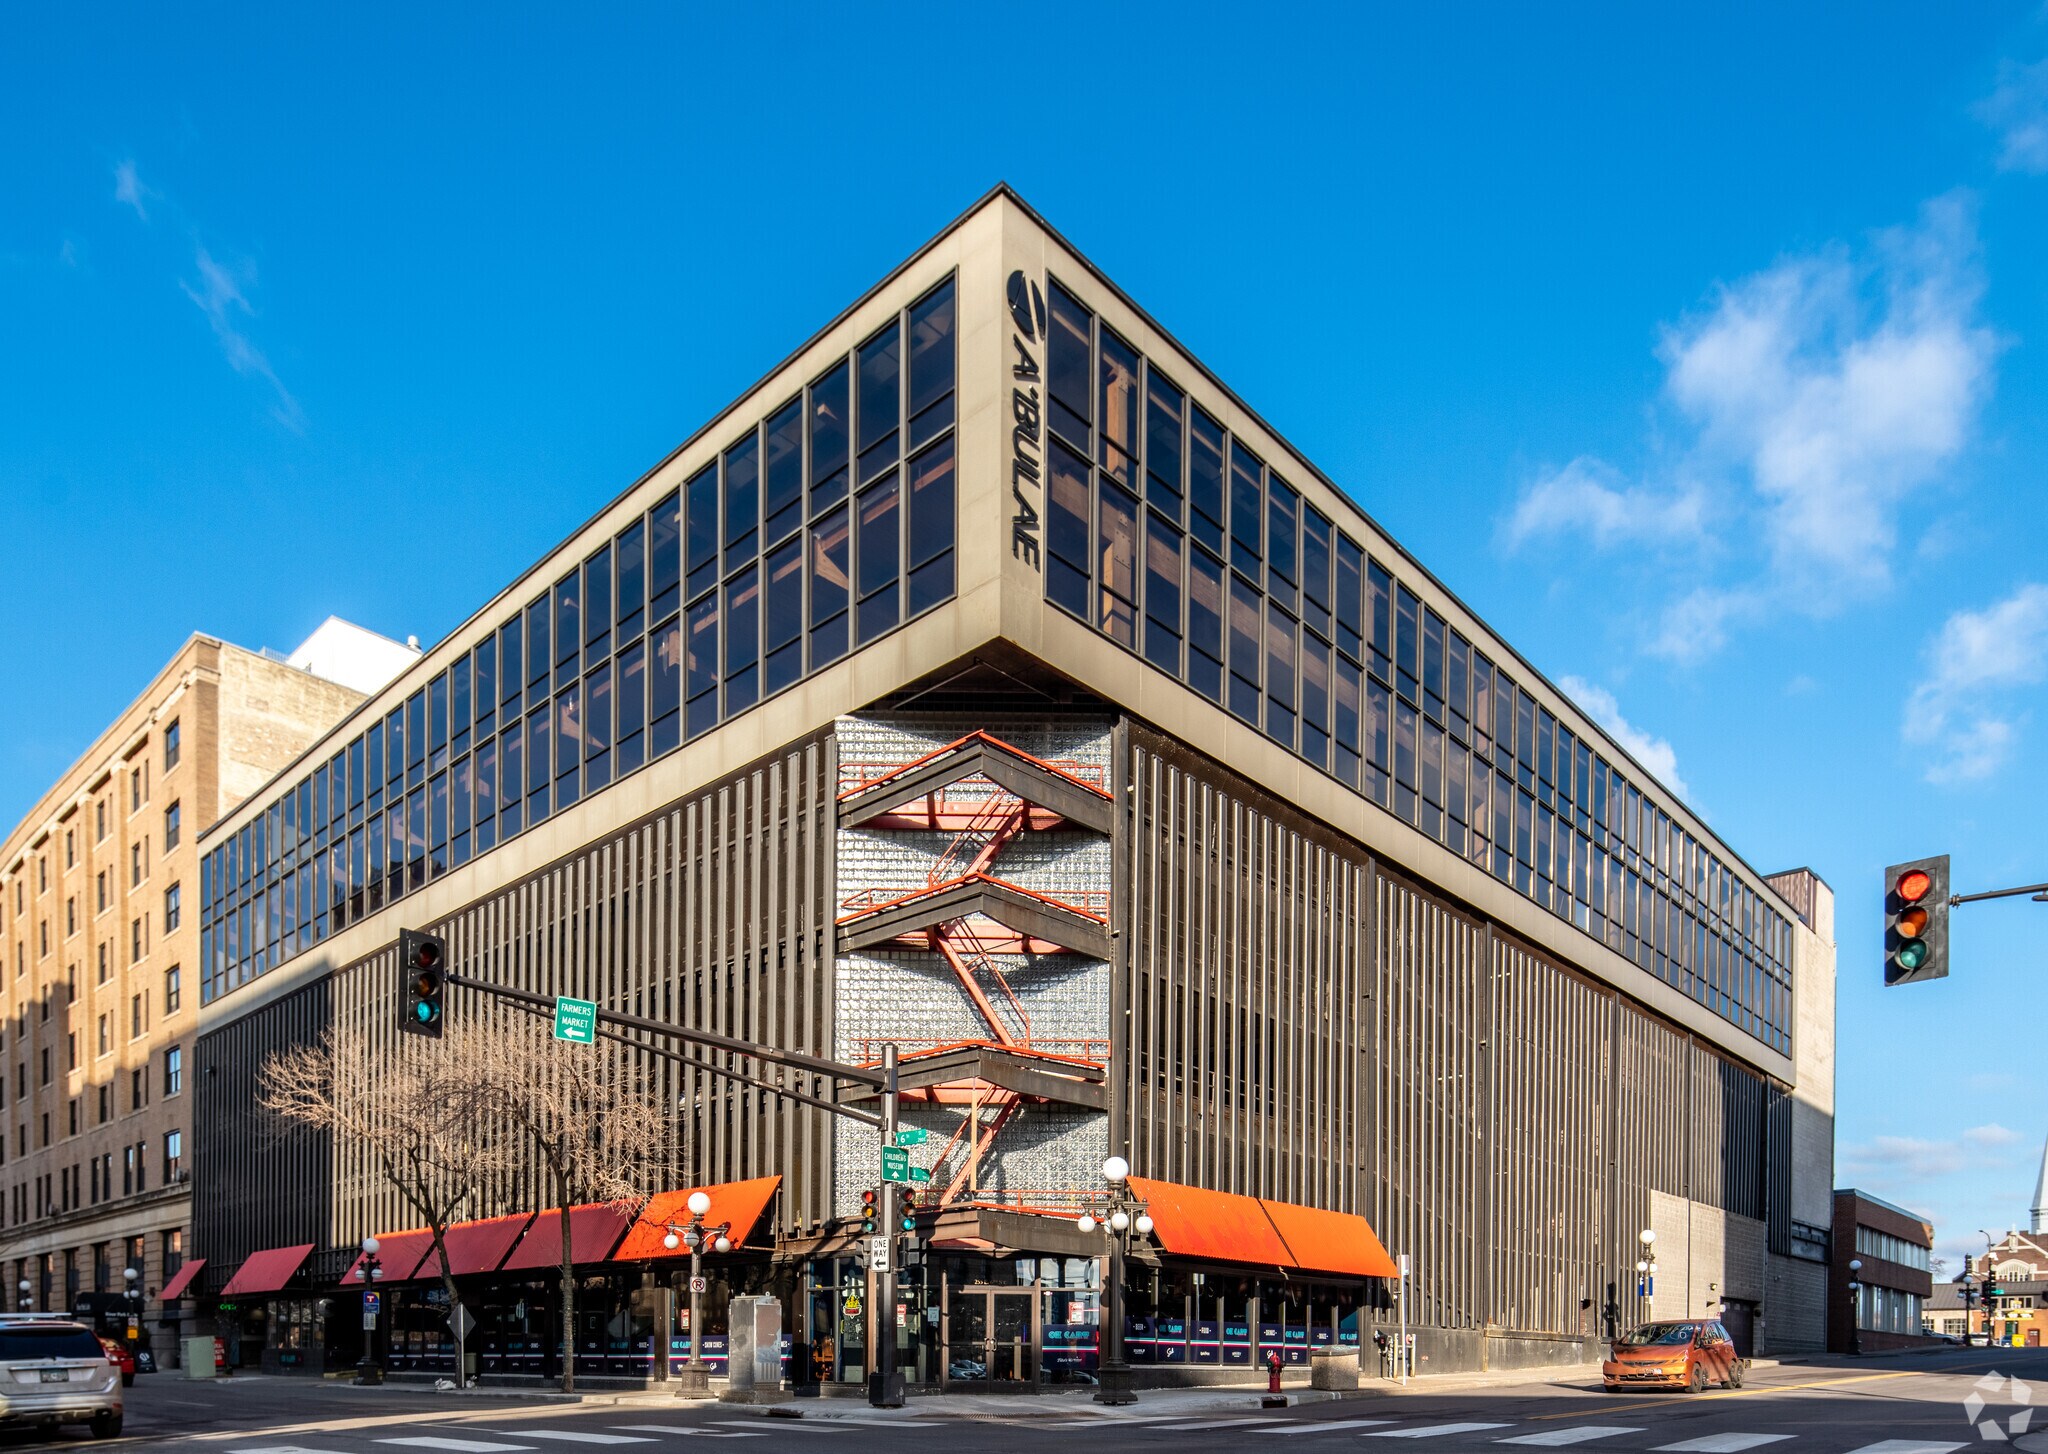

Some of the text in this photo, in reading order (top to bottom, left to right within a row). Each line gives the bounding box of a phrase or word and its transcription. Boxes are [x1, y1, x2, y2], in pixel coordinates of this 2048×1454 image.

[561, 1003, 592, 1016] FARMERS
[561, 1016, 589, 1028] MARKET
[887, 1162, 904, 1171] MUSEUM
[873, 1239, 887, 1249] ONE
[873, 1249, 887, 1258] WAY
